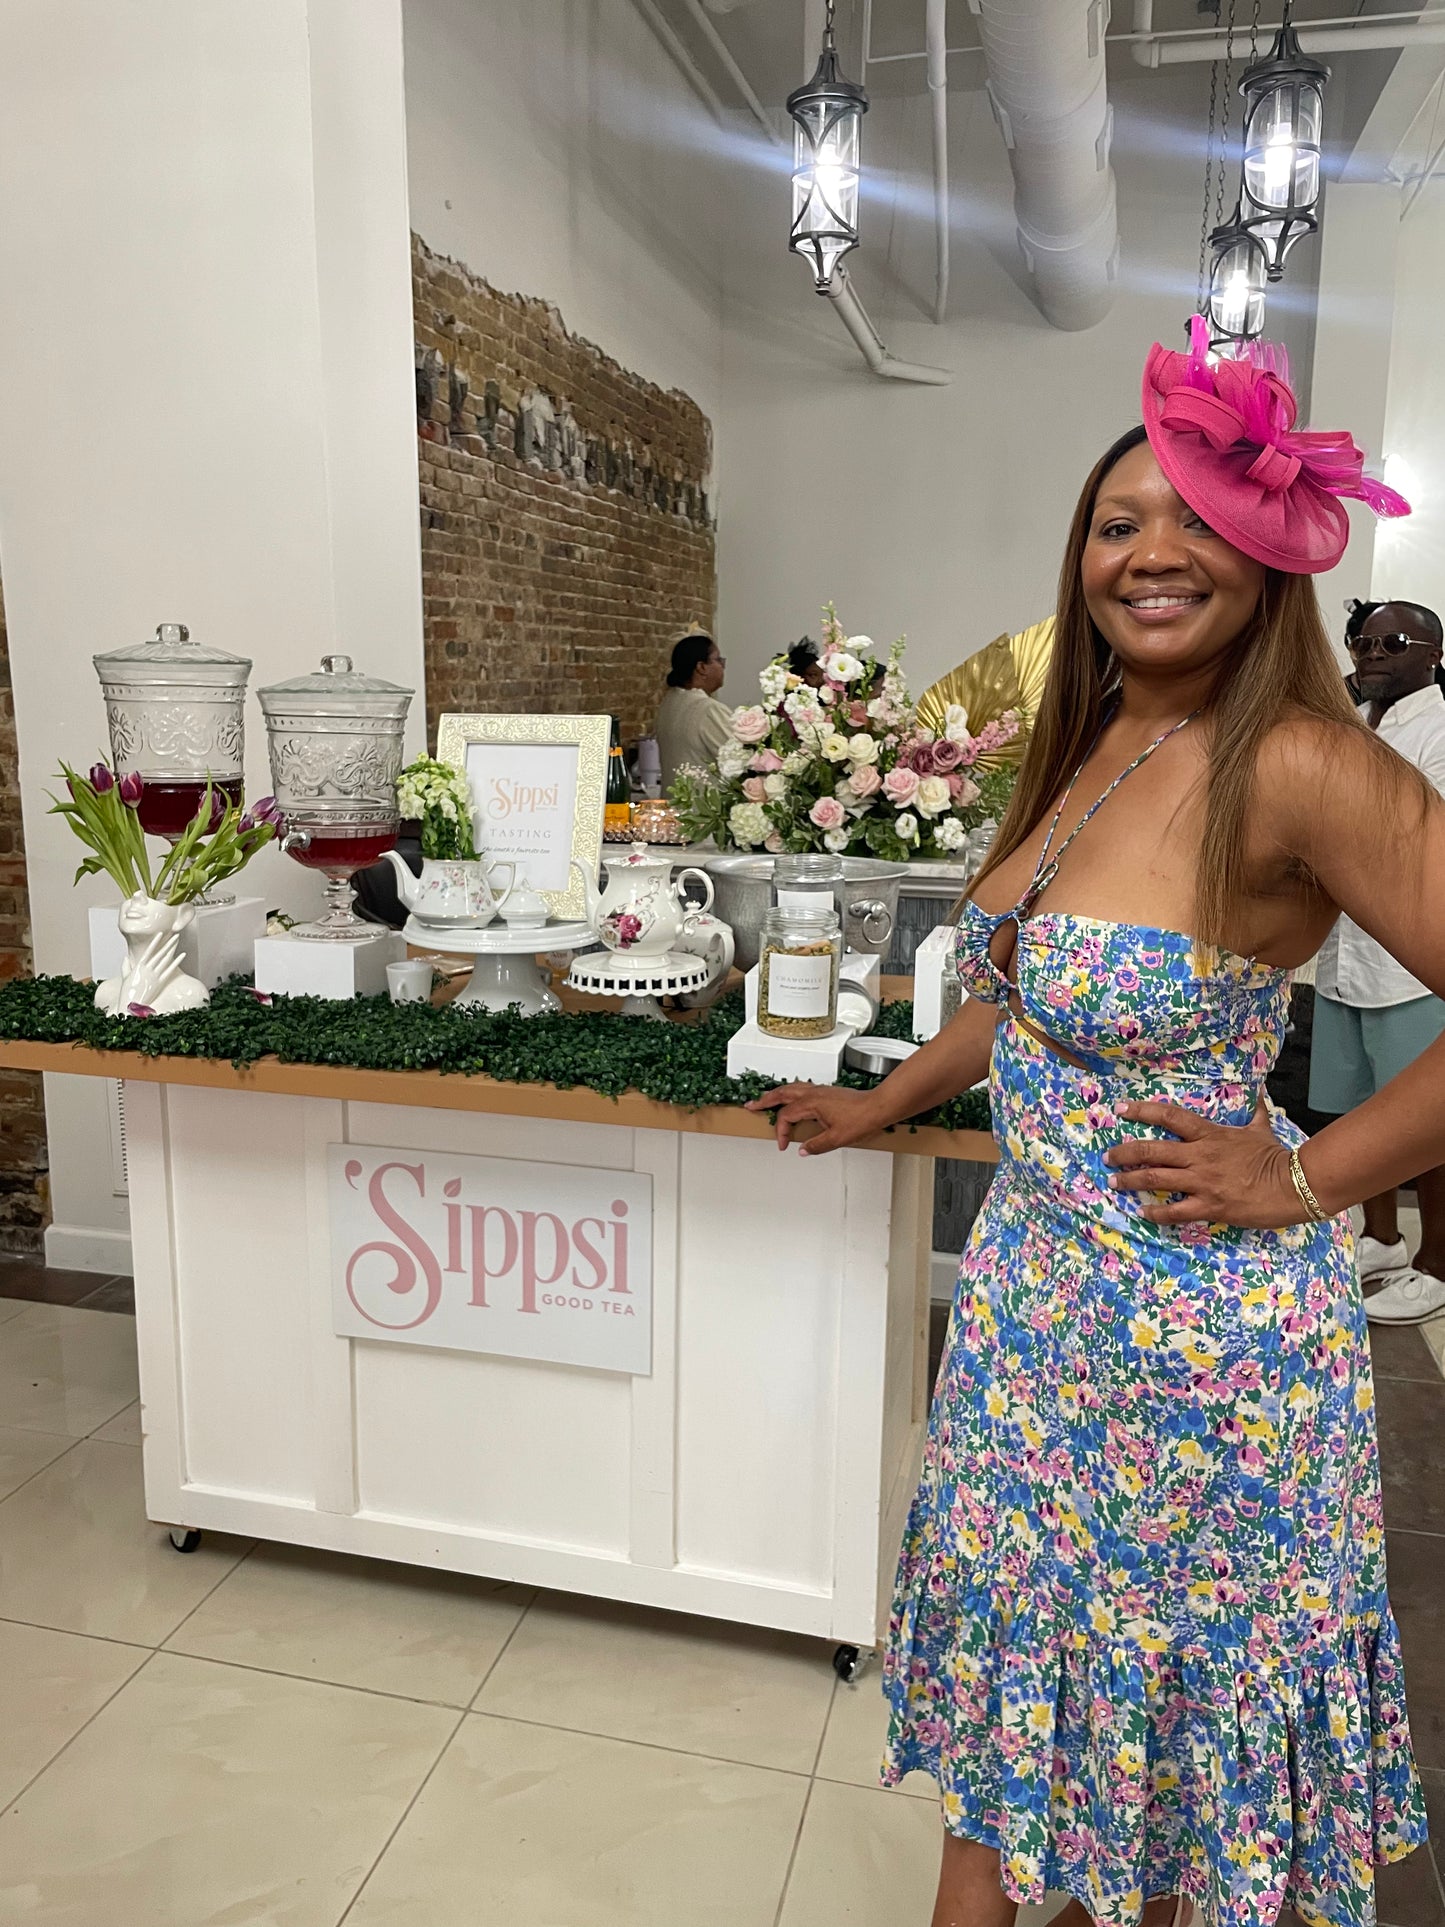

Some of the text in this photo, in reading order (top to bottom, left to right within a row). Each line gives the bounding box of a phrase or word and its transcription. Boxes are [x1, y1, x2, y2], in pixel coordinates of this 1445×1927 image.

[489, 828, 552, 839] TASTING
[775, 976, 823, 984] CHAMOMILE
[345, 1159, 633, 1330] 'Sippsi
[541, 1293, 636, 1316] GOOD TEA
